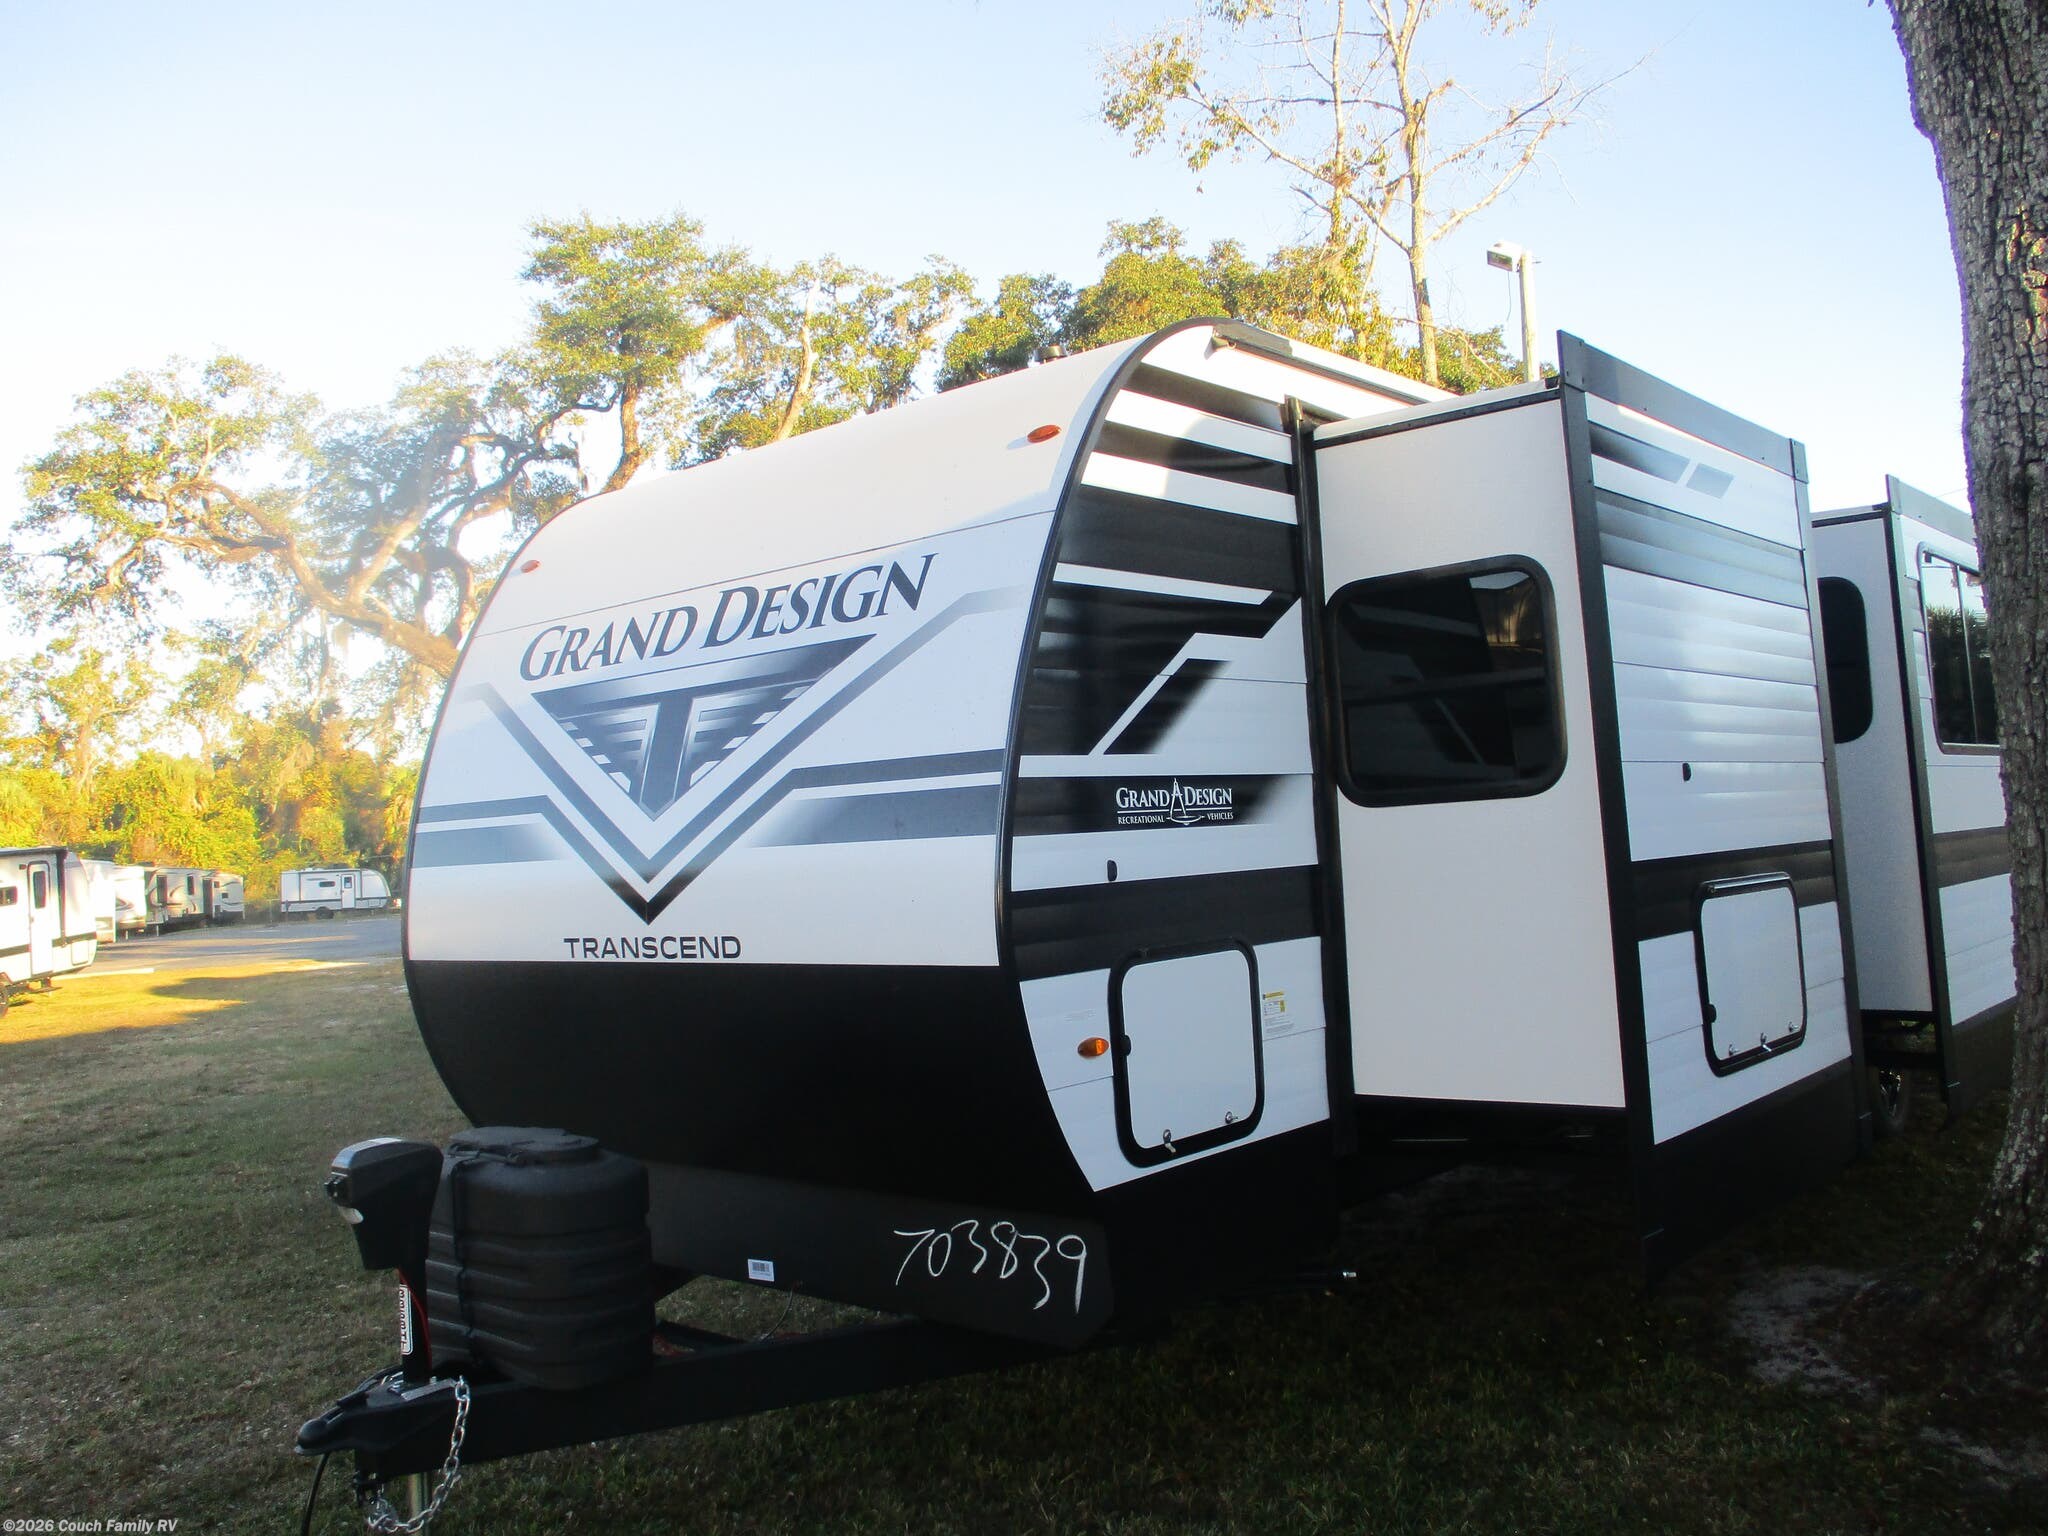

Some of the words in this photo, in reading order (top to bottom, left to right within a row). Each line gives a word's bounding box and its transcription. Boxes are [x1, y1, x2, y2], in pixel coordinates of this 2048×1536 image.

[520, 606, 698, 681] GRAND
[699, 553, 938, 649] DESIGN
[1116, 787, 1170, 808] GRAND
[1183, 786, 1233, 806] DESIGN
[1118, 815, 1165, 824] RECREATIONAL
[1207, 812, 1234, 820] VEHICLES
[564, 936, 742, 959] TRANSCEND
[893, 1219, 1087, 1314] 703839
